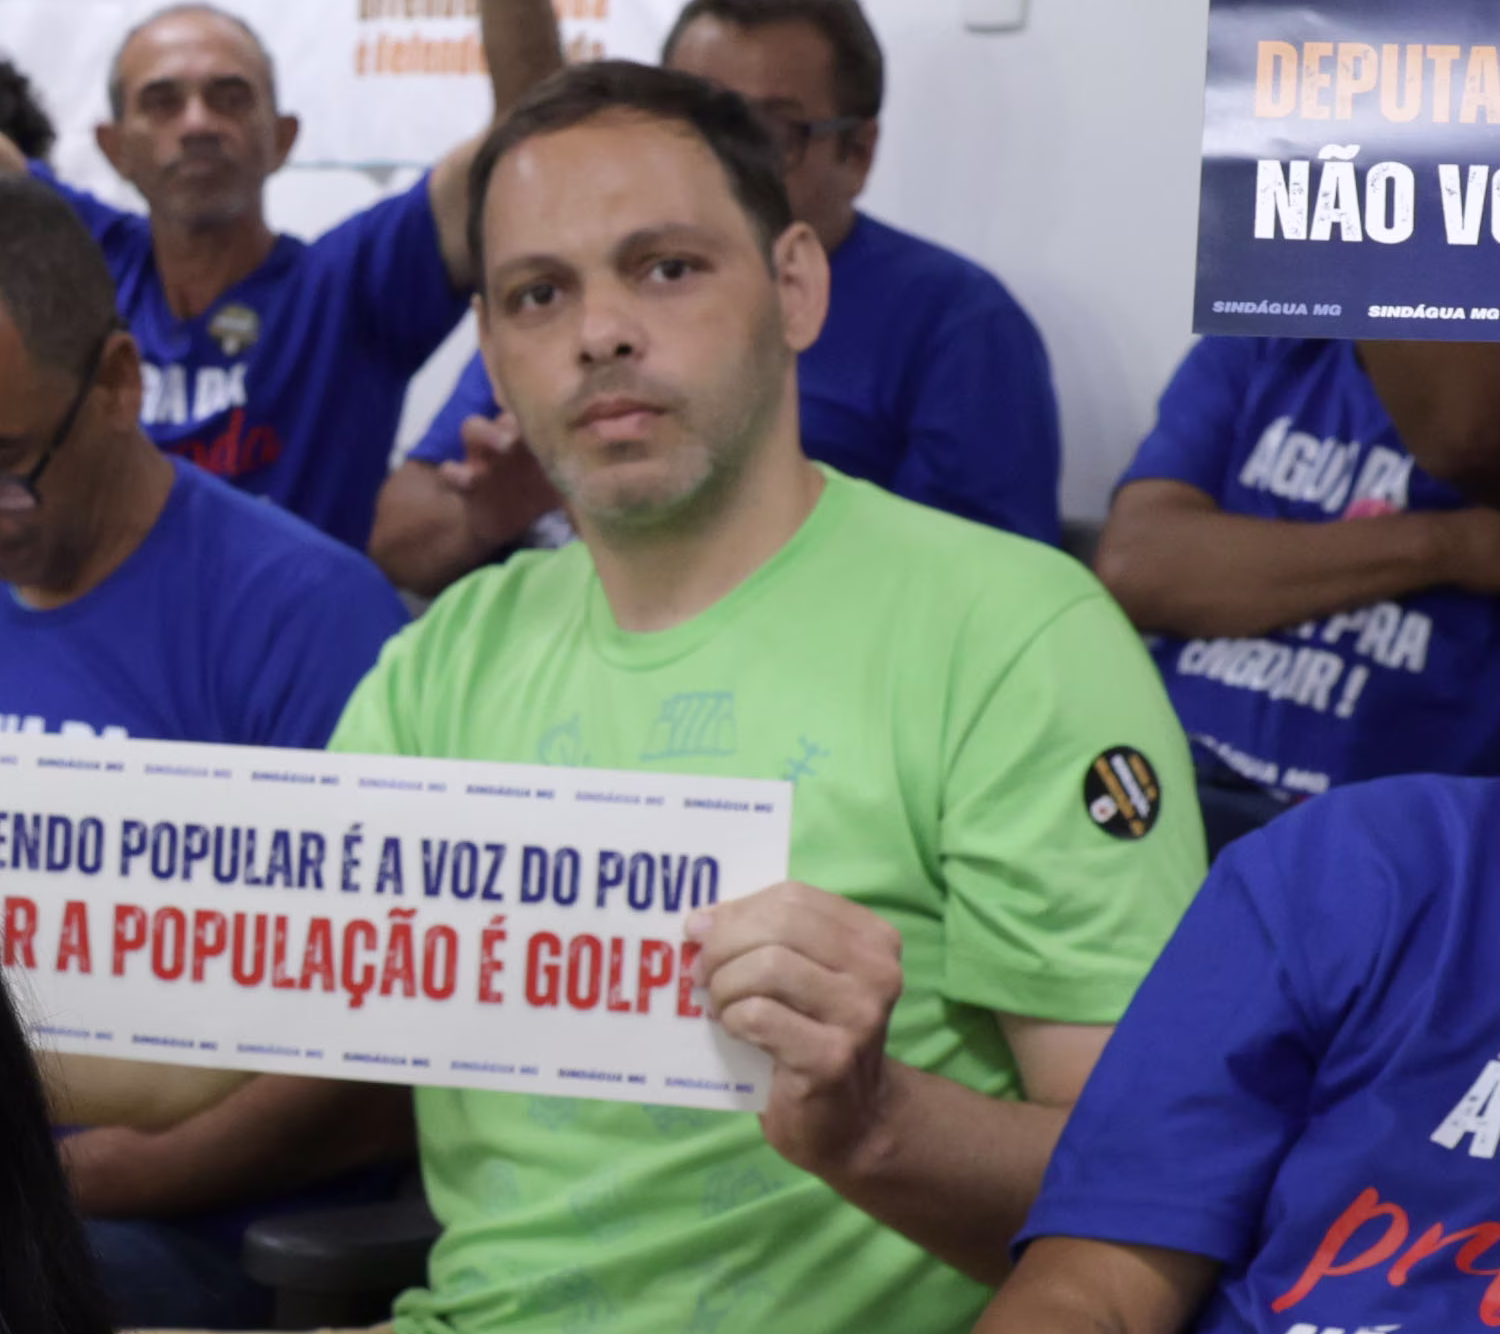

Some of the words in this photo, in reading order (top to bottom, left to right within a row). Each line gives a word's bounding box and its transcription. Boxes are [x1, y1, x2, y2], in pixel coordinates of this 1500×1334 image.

[1254, 145, 1414, 246] NÃO
[1368, 305, 1462, 320] SINDÁGUA
[1467, 306, 1499, 321] MG
[120, 820, 325, 888] POPULAR
[341, 823, 363, 892] É
[376, 838, 404, 895] A
[422, 839, 505, 901] VOZ
[520, 845, 581, 905] DO
[596, 850, 719, 912] POVO
[57, 900, 92, 974] A
[113, 908, 458, 1008] POPULAÇÃO
[479, 915, 506, 1004] É
[525, 931, 712, 1021] GOLPE
